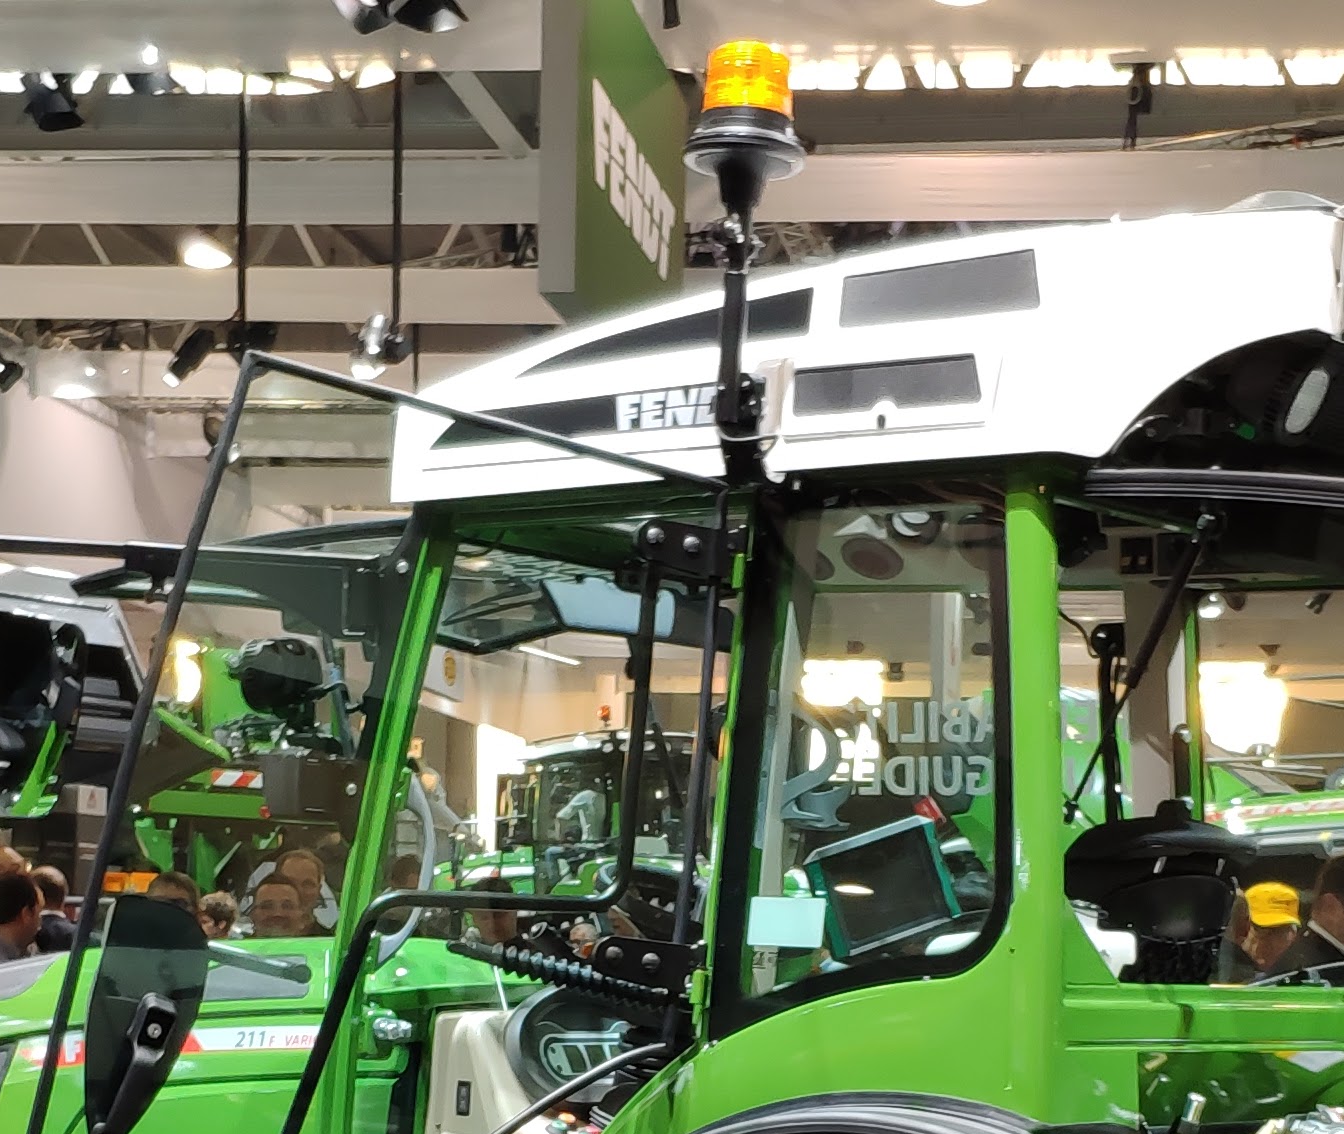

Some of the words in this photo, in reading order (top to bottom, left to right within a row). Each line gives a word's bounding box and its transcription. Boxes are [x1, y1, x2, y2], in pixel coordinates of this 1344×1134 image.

[592, 77, 676, 282] FENDT
[616, 386, 718, 432] FEND
[234, 1030, 266, 1049] 211
